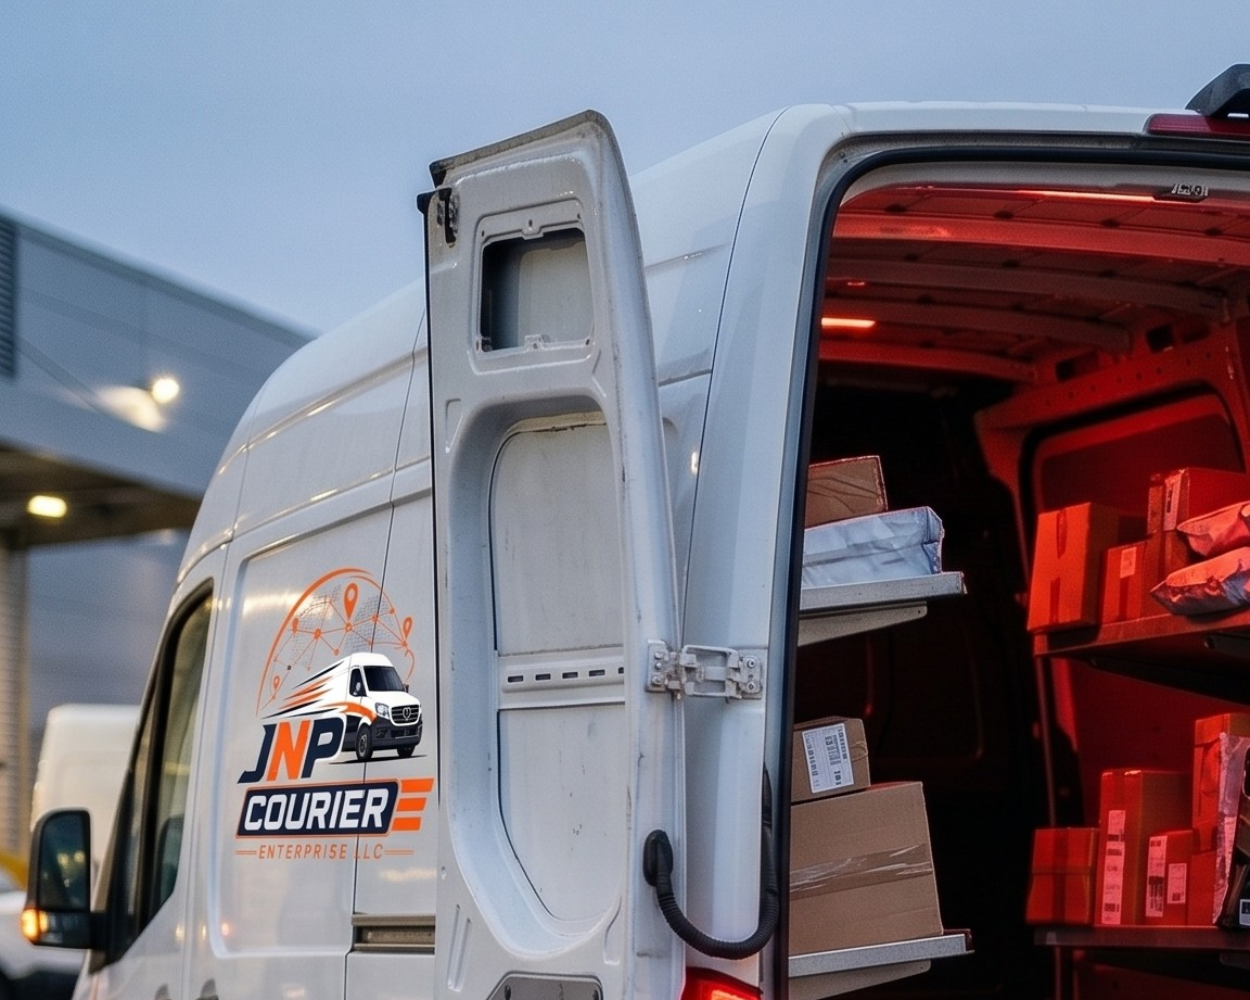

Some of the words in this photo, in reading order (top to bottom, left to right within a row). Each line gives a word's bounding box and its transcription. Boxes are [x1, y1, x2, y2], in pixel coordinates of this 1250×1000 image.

[237, 717, 345, 784] JNP
[244, 788, 390, 831] COURIER
[258, 844, 348, 859] ENTERPRISE
